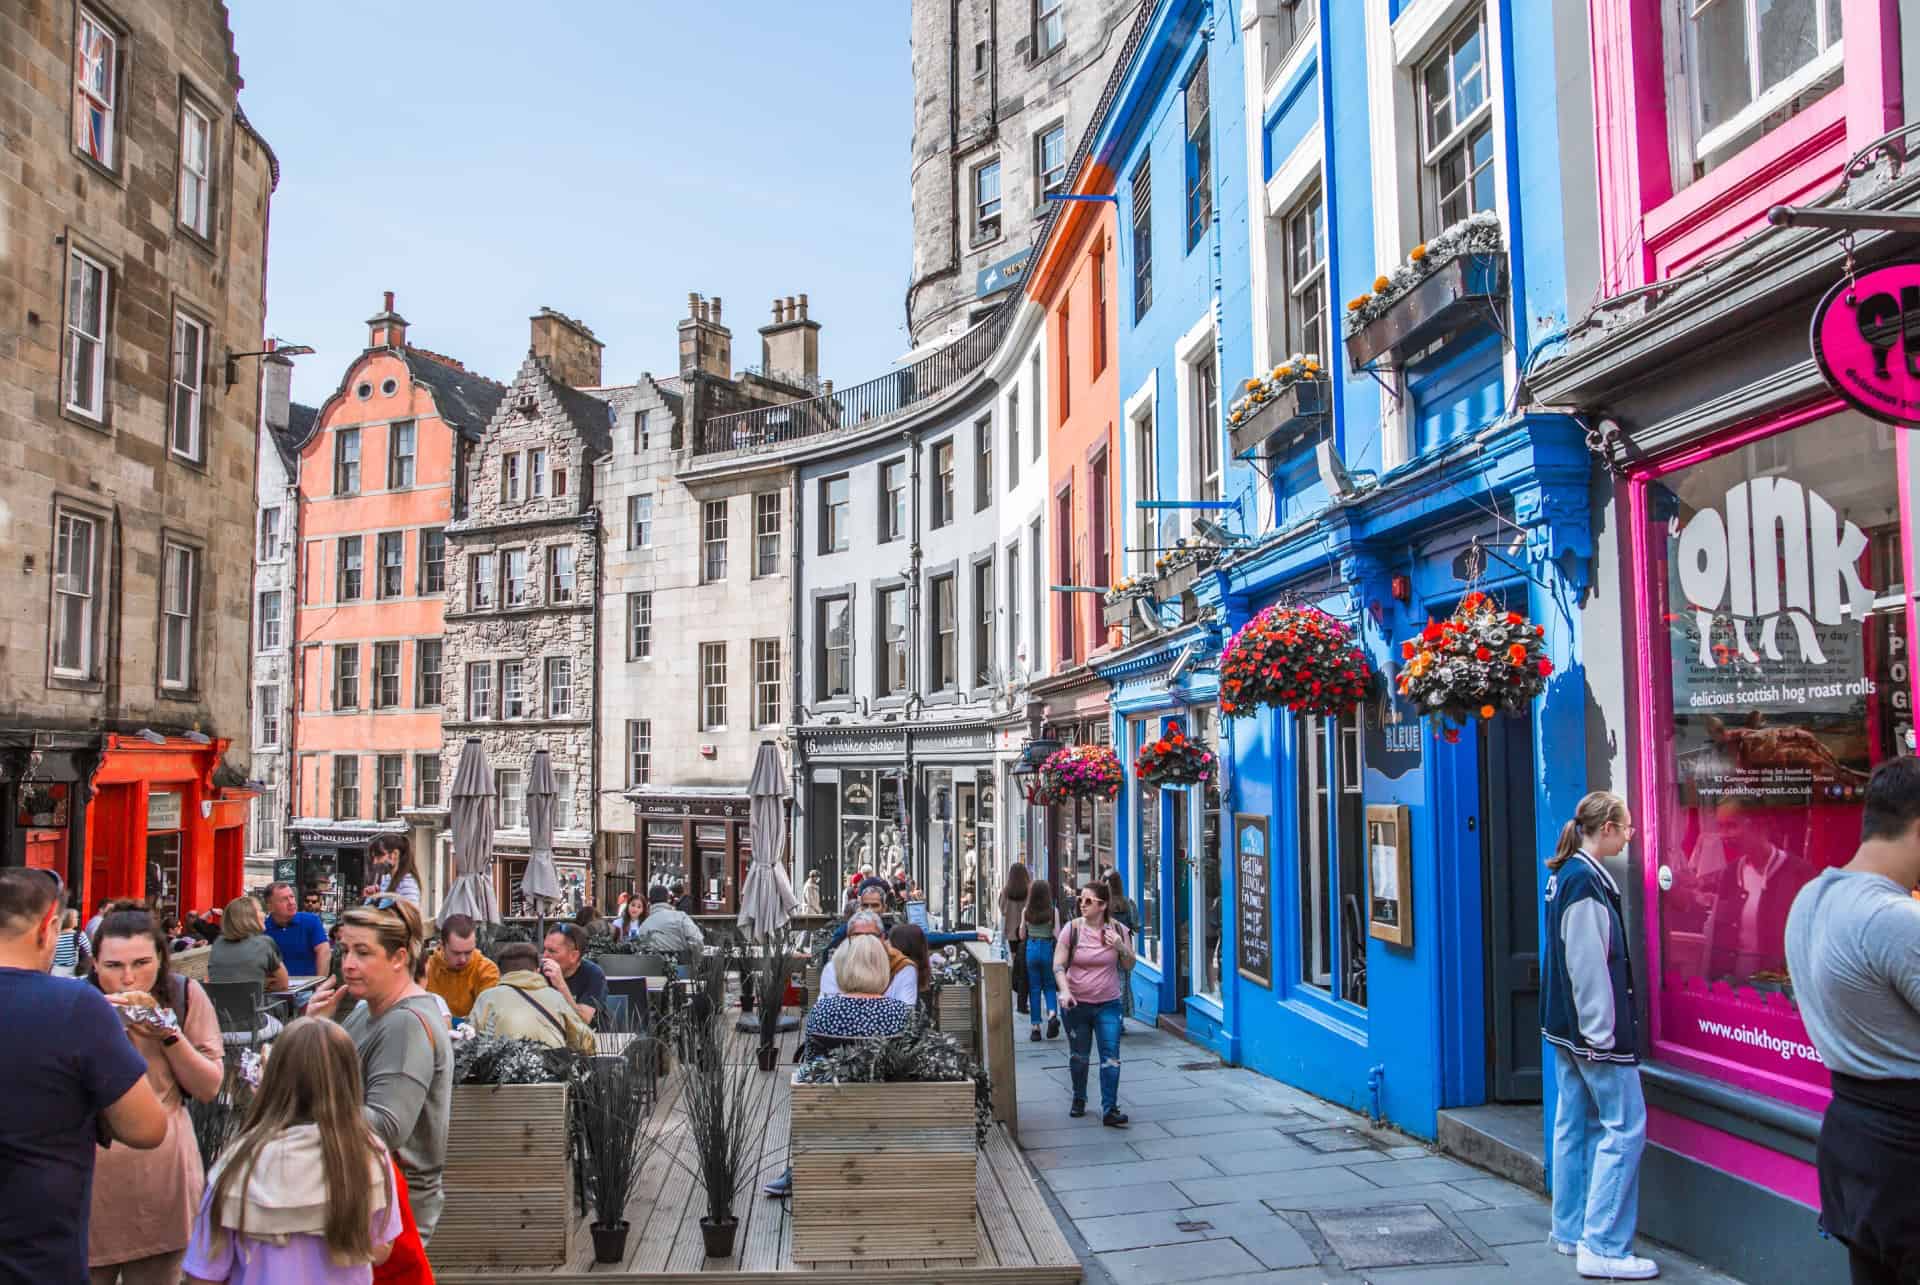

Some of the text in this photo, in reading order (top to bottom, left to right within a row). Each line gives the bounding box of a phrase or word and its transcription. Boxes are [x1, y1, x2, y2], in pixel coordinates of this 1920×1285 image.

[1830, 630, 1849, 641] day
[1690, 677, 1876, 707] delicious scottish hog roast rolls
[1698, 785, 1813, 797] www.oinkhogroast.co.uk
